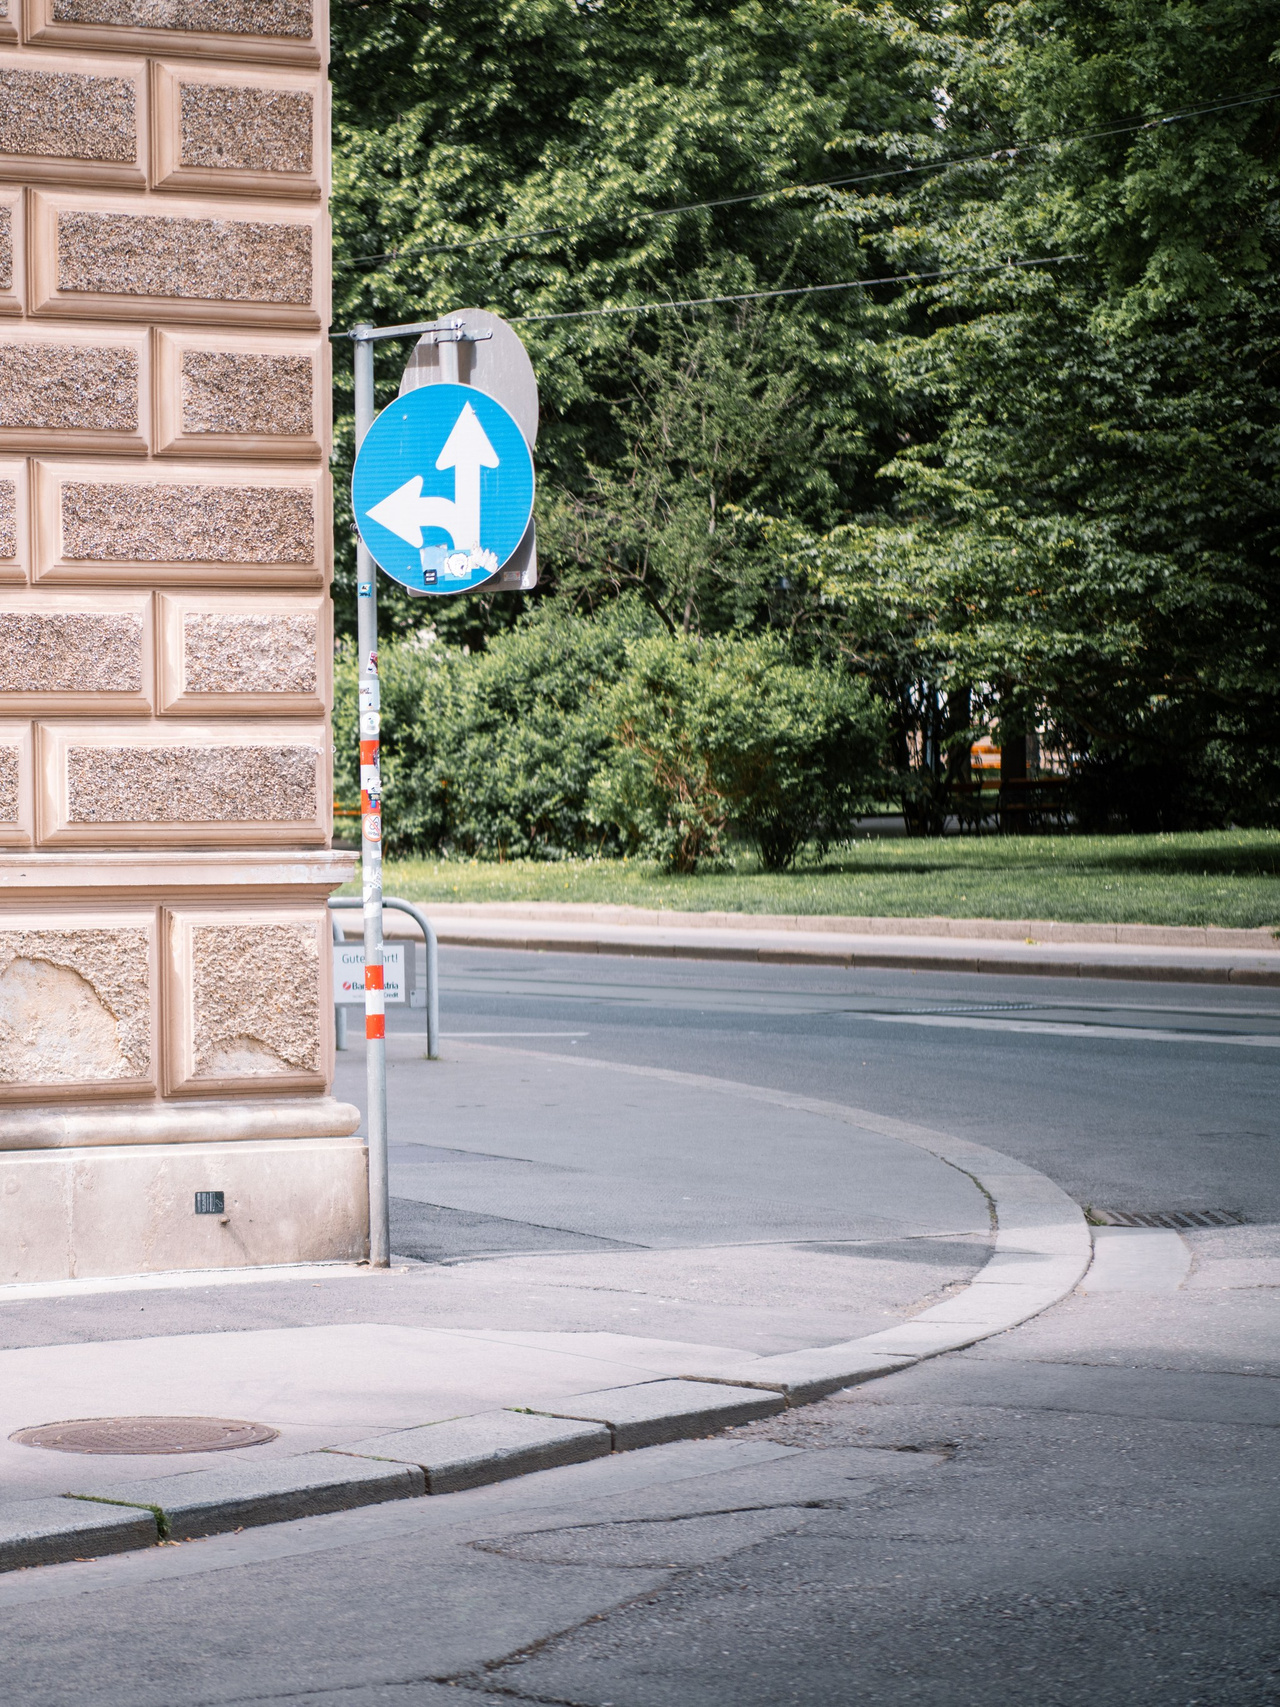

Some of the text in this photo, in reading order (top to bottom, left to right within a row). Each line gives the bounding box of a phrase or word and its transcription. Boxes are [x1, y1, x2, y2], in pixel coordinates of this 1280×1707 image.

[341, 953, 365, 964] Gute
[351, 981, 399, 990] Ban stria
